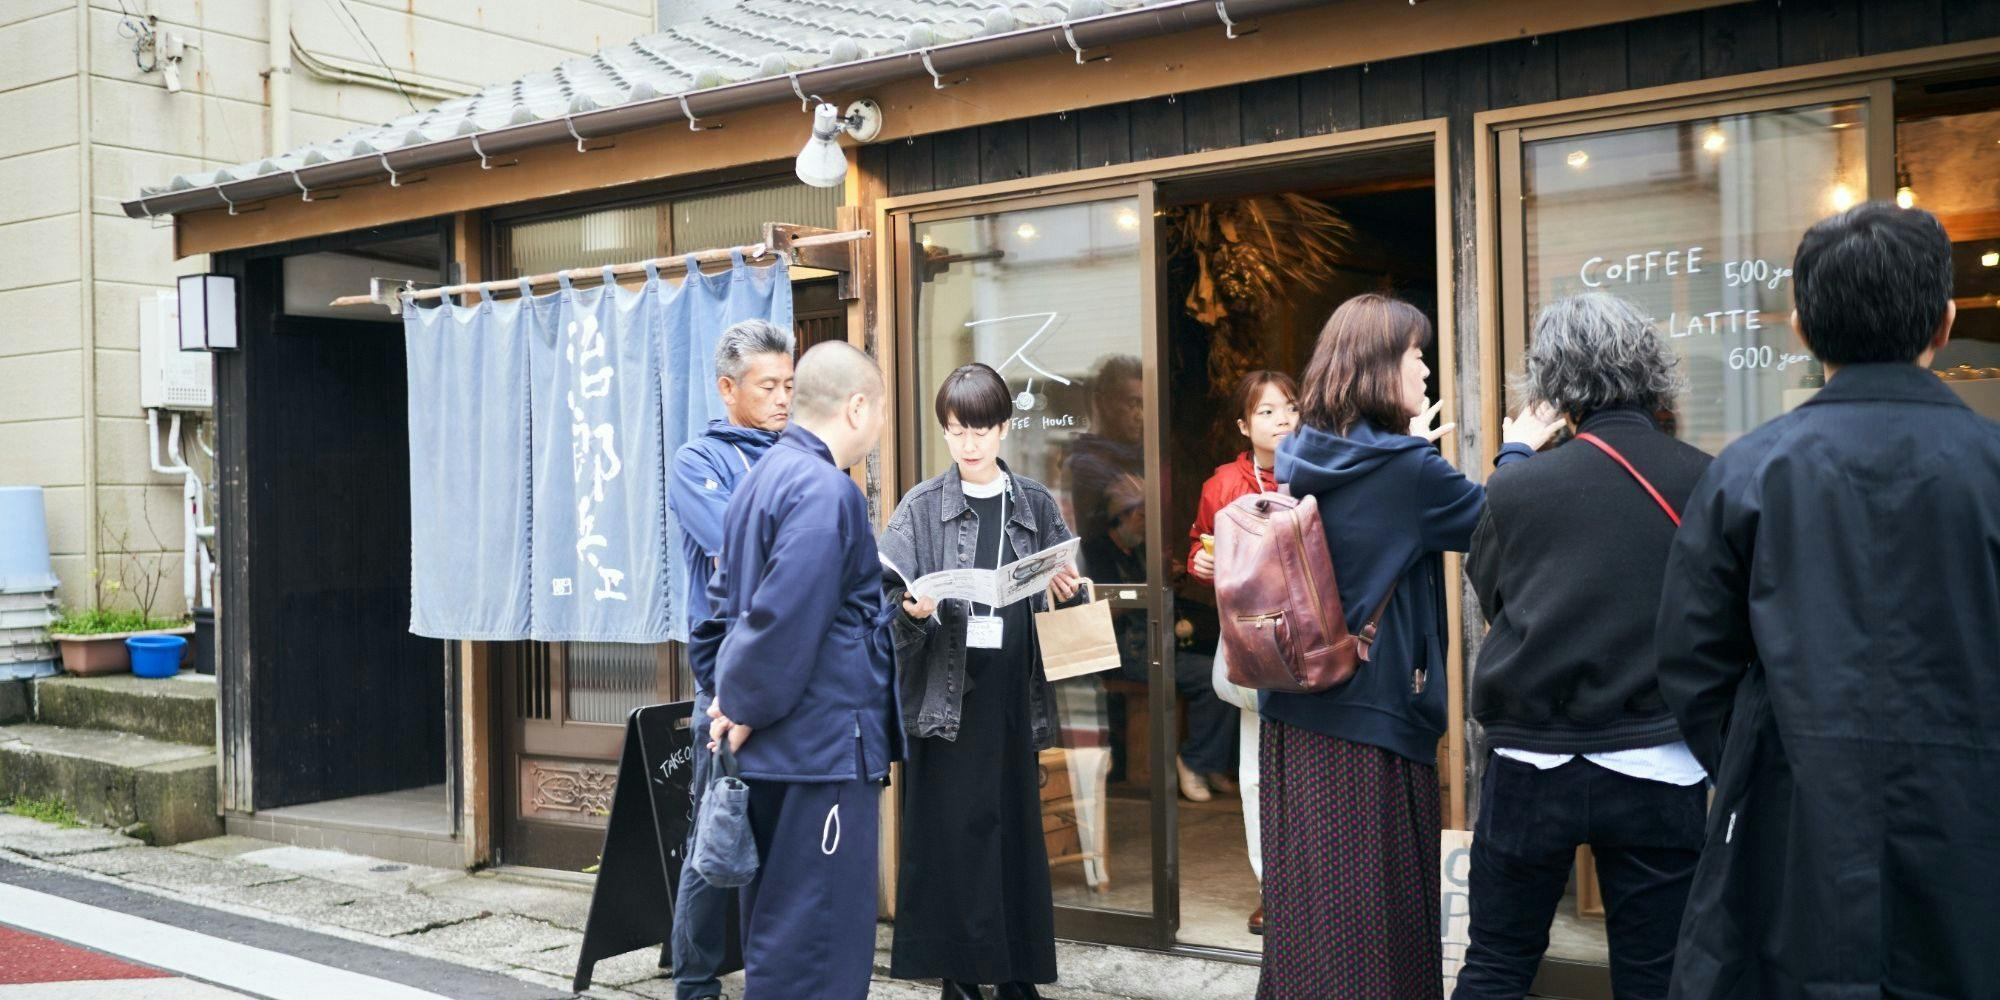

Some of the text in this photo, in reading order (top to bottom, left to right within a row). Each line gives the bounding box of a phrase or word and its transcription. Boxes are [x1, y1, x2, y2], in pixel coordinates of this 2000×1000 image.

[1724, 259, 1794, 290] 500 ye
[1669, 309, 1763, 338] LATTE
[1728, 345, 1812, 371] 600 yen
[1010, 416, 1031, 430] FEE
[659, 745, 693, 779] TAKEO
